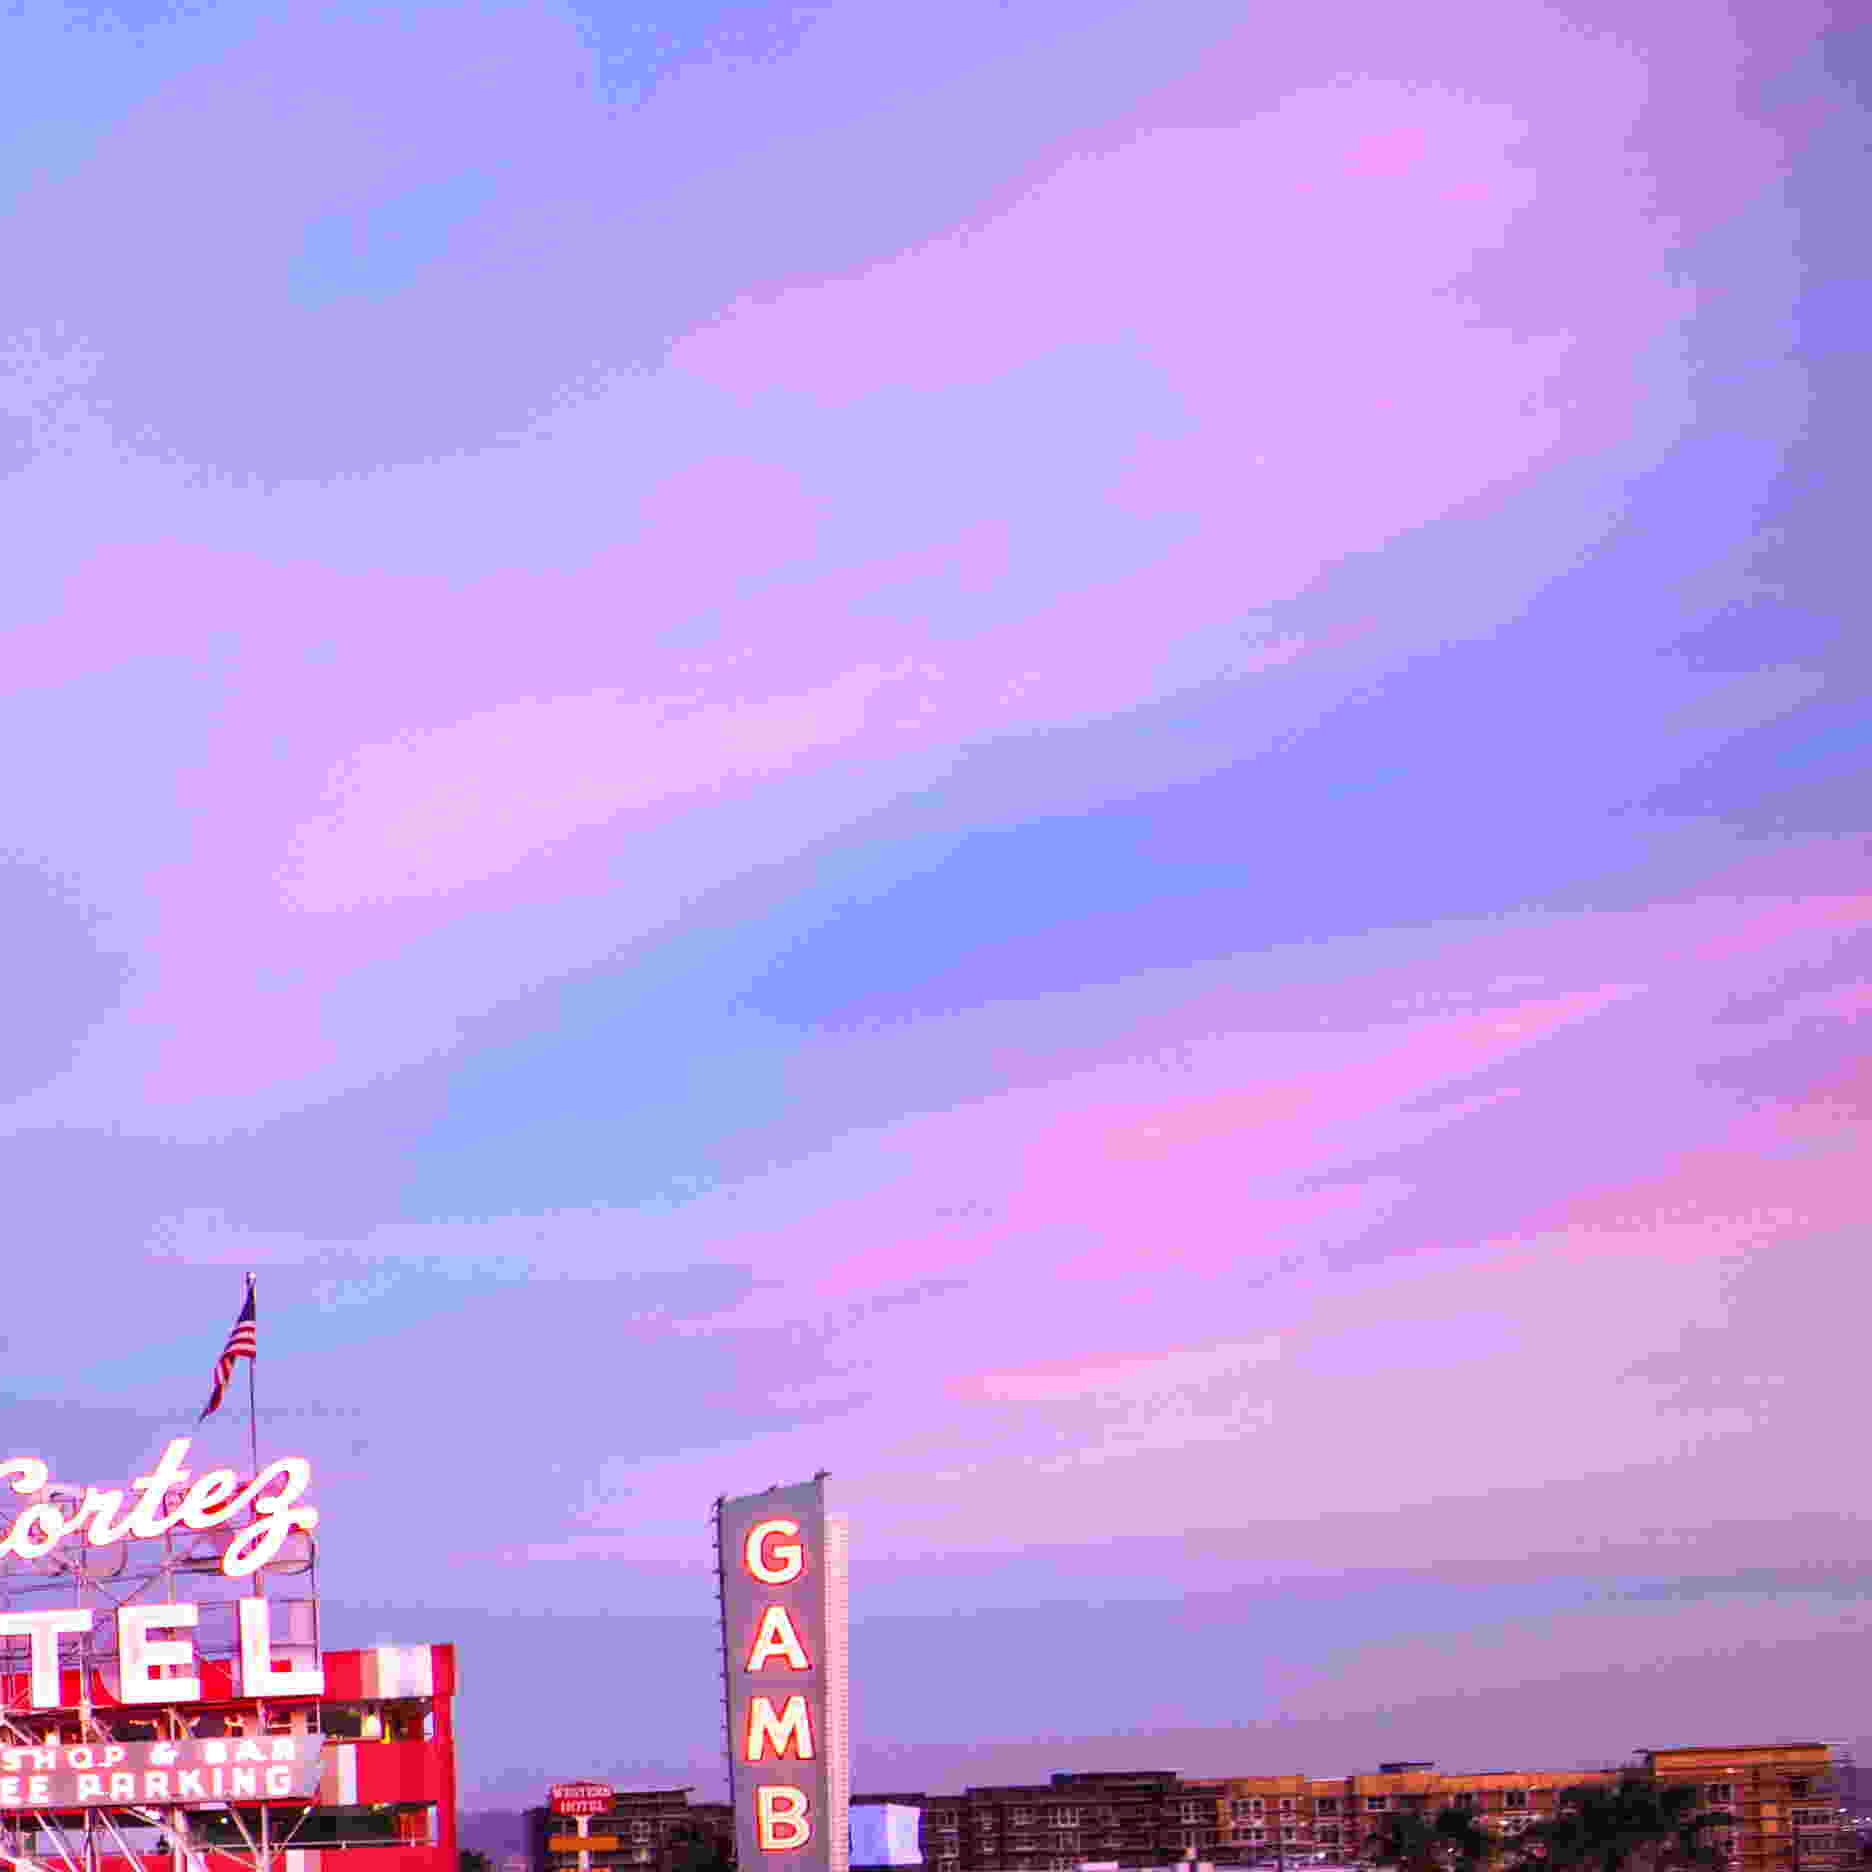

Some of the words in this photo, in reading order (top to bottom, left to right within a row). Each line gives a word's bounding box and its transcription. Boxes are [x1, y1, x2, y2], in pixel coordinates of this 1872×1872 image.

[0, 1743, 131, 1772] SHOP
[202, 1737, 297, 1764] BAR
[78, 1765, 294, 1802] PARKING
